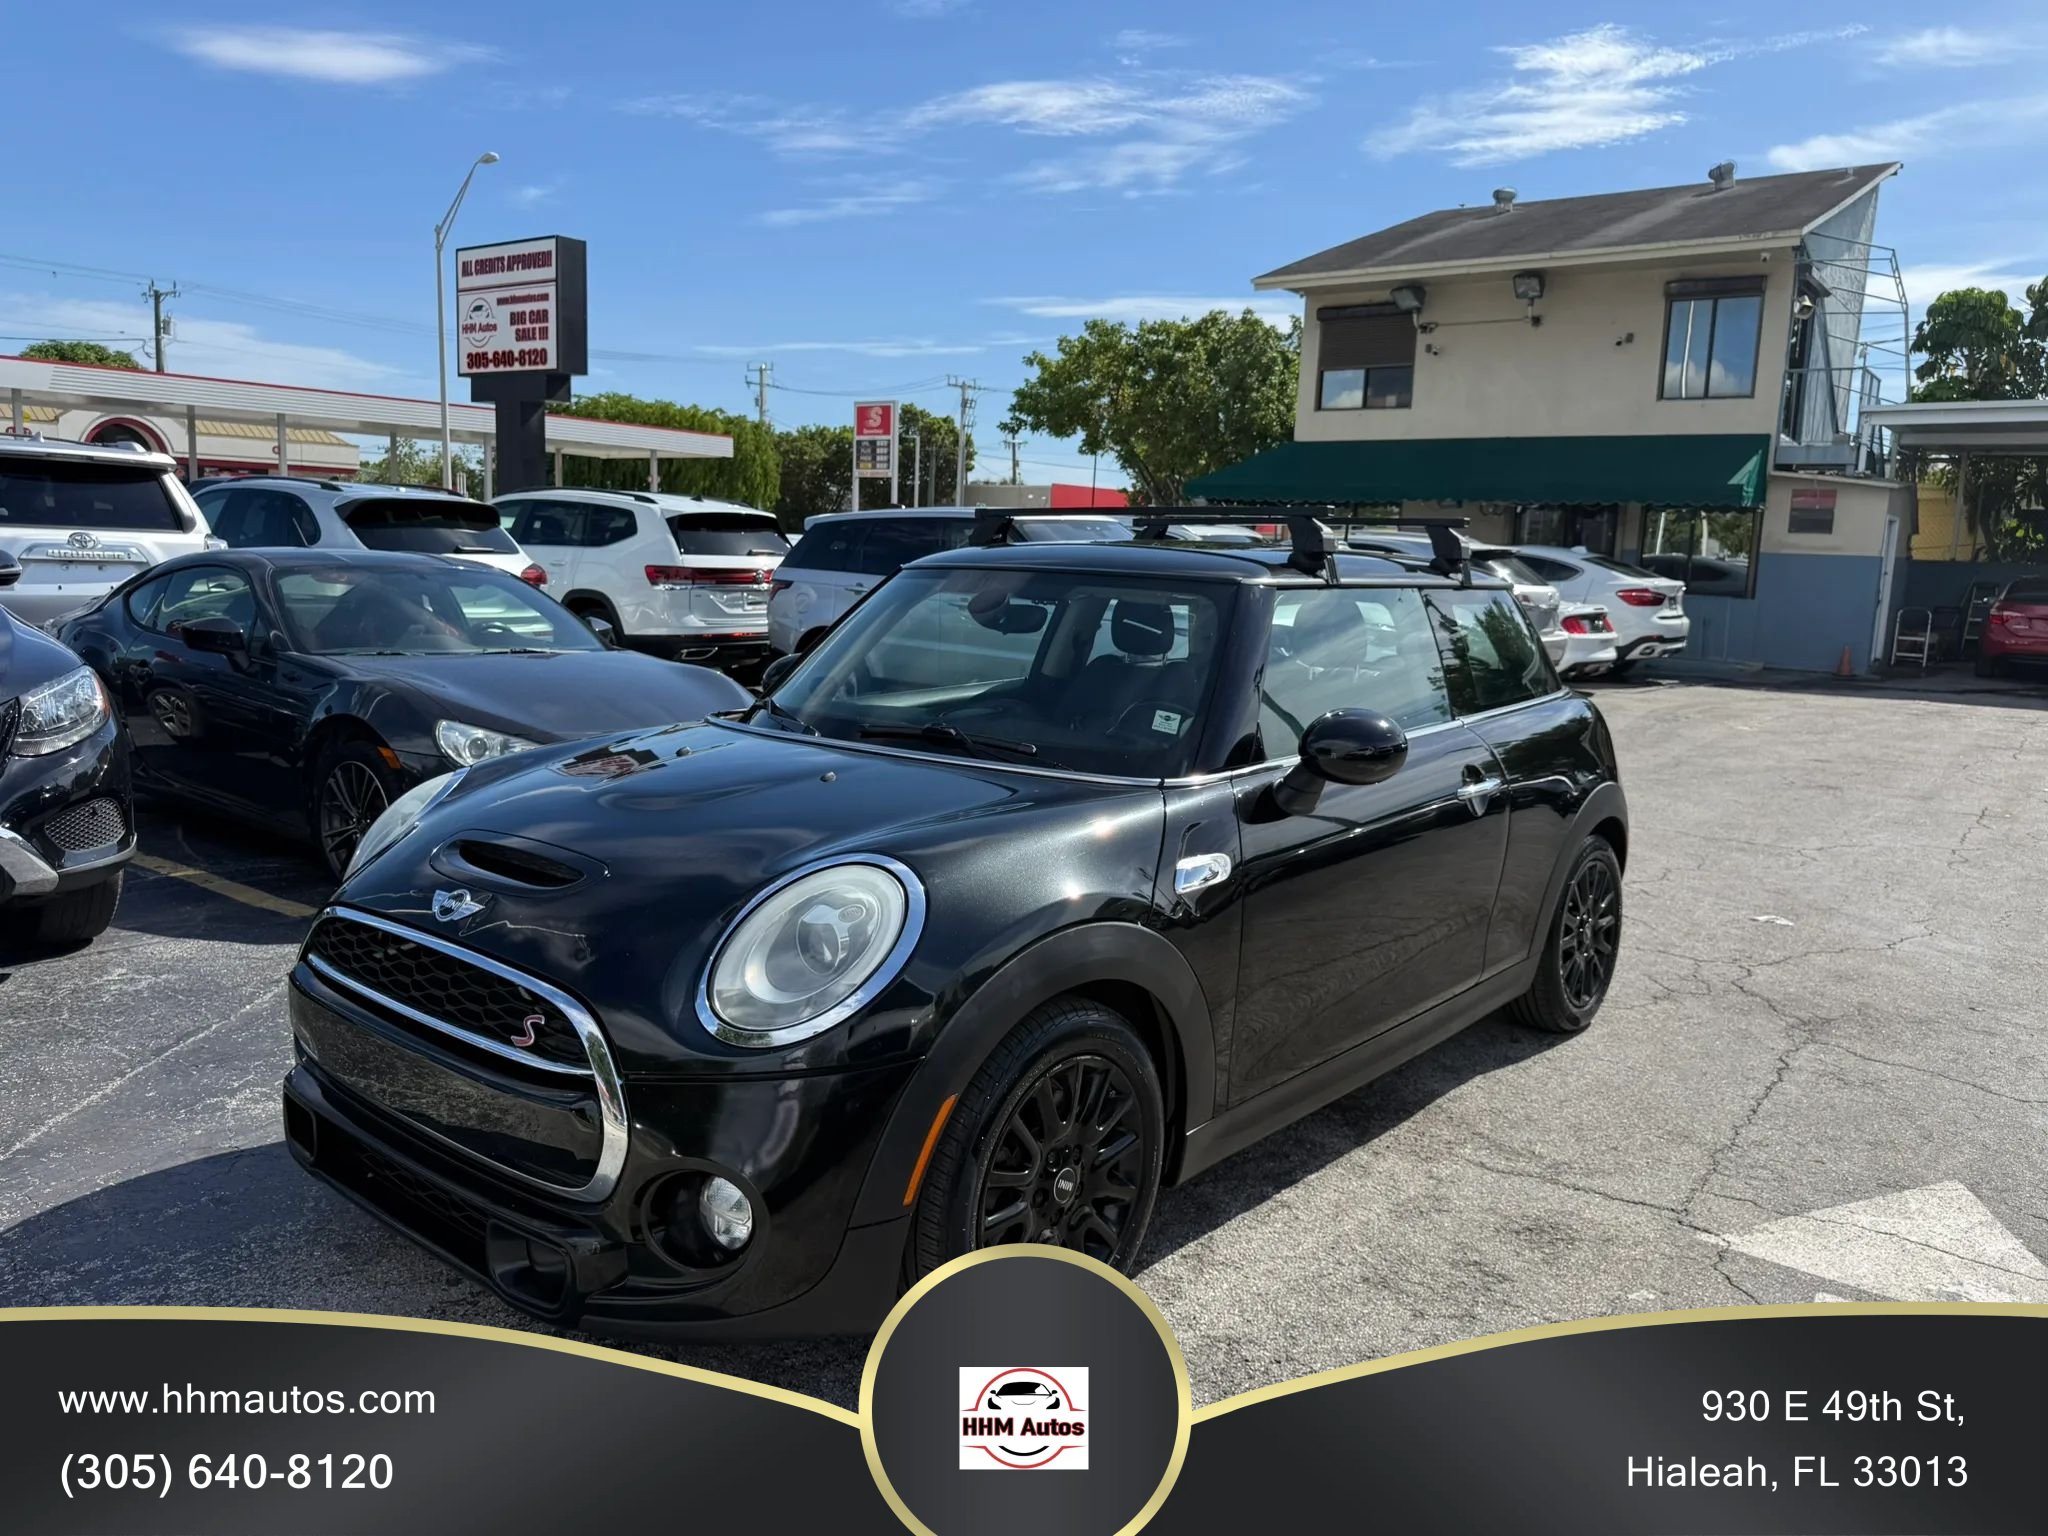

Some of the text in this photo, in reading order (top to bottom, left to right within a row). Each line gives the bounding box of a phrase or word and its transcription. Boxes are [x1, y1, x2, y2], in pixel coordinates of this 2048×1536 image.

[462, 260, 474, 277] ALL
[475, 257, 506, 275] CREDITS
[510, 309, 549, 326] BIG CAR
[462, 322, 498, 335] HHM Autos
[515, 327, 538, 342] SALE
[467, 348, 548, 369] 305-640-8120
[509, 1014, 546, 1047] S
[1057, 1178, 1074, 1192] MINI
